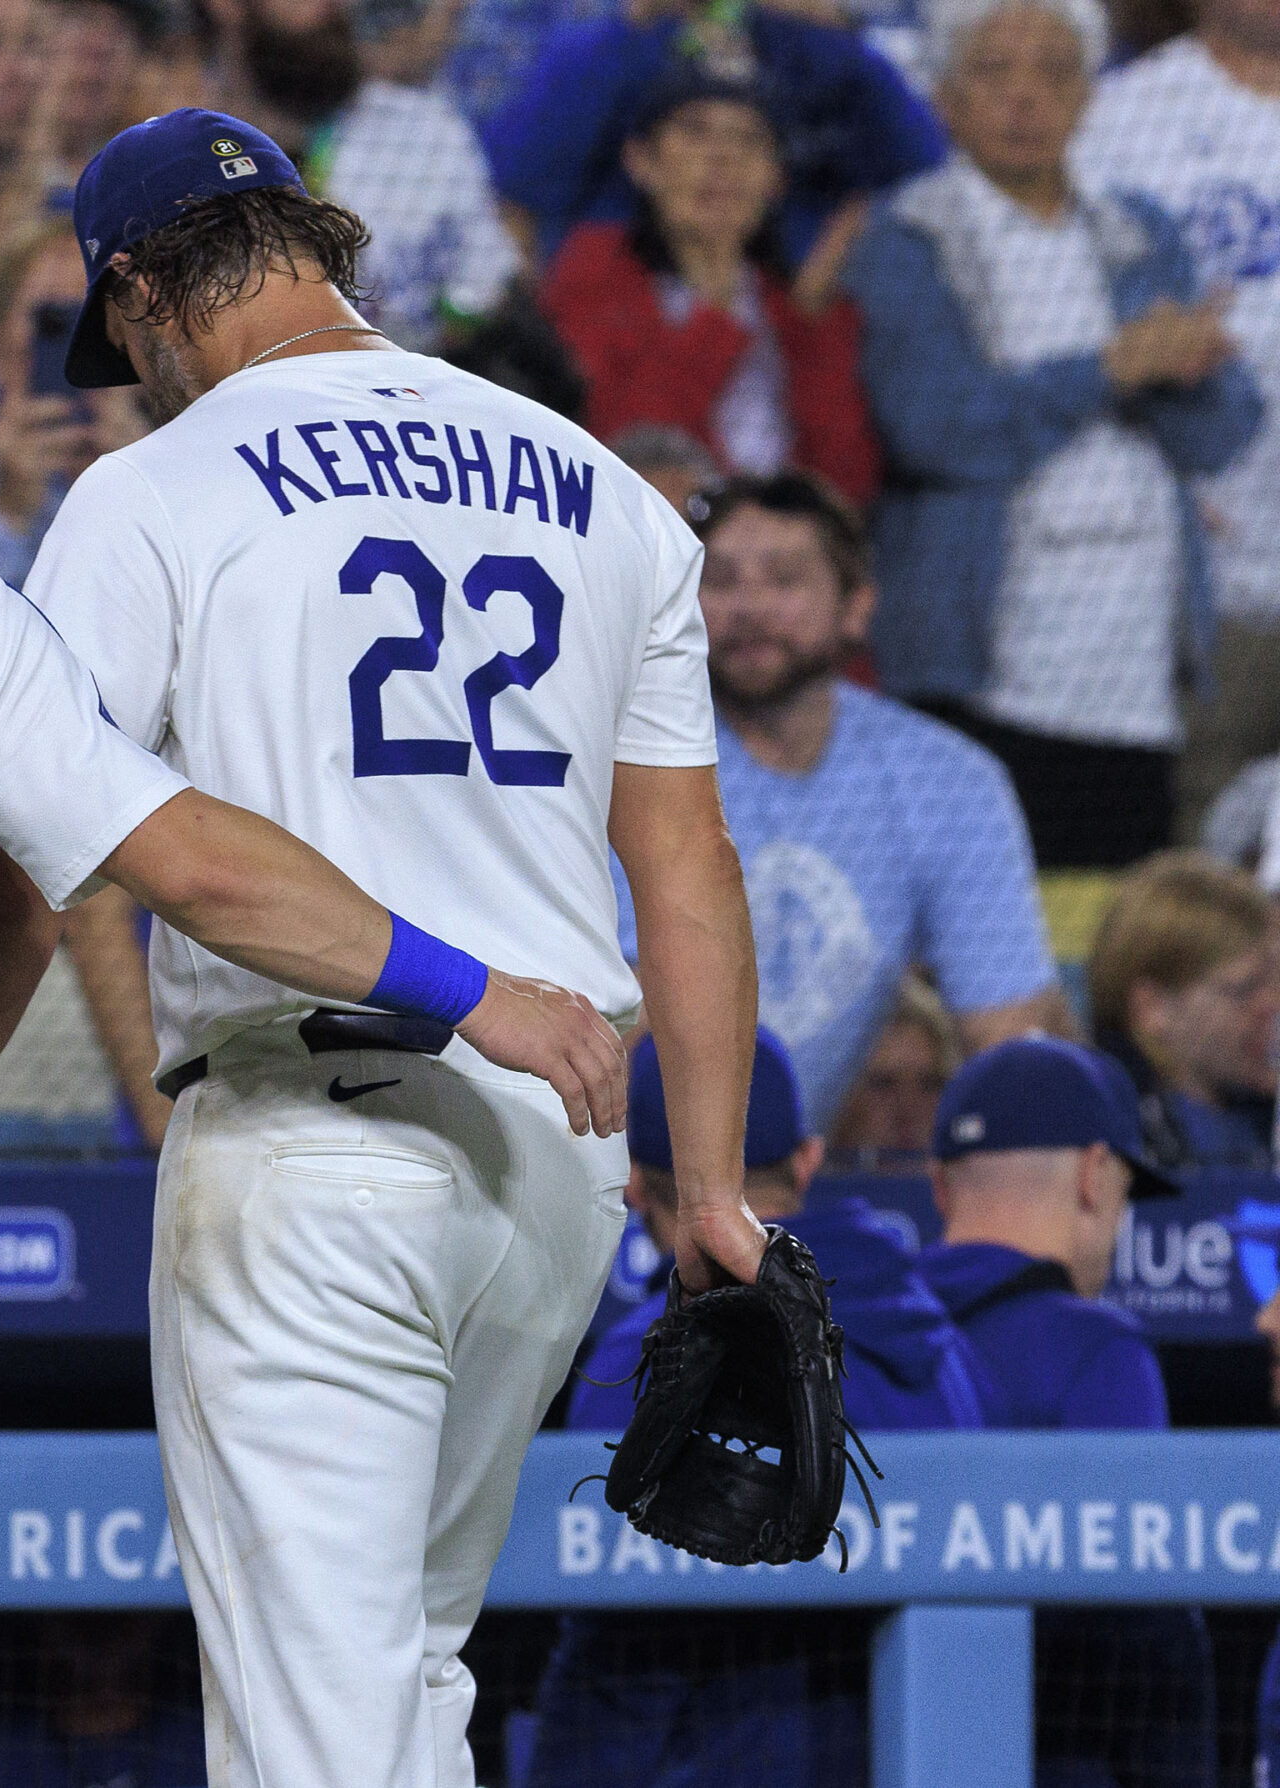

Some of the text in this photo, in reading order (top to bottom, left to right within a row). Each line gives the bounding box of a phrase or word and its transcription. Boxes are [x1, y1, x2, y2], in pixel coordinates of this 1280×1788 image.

[218, 142, 237, 153] 21
[235, 420, 594, 538] KERSHAW
[339, 535, 572, 787] 22
[822, 1501, 919, 1575] OF
[941, 1501, 1280, 1573] AMERIC
